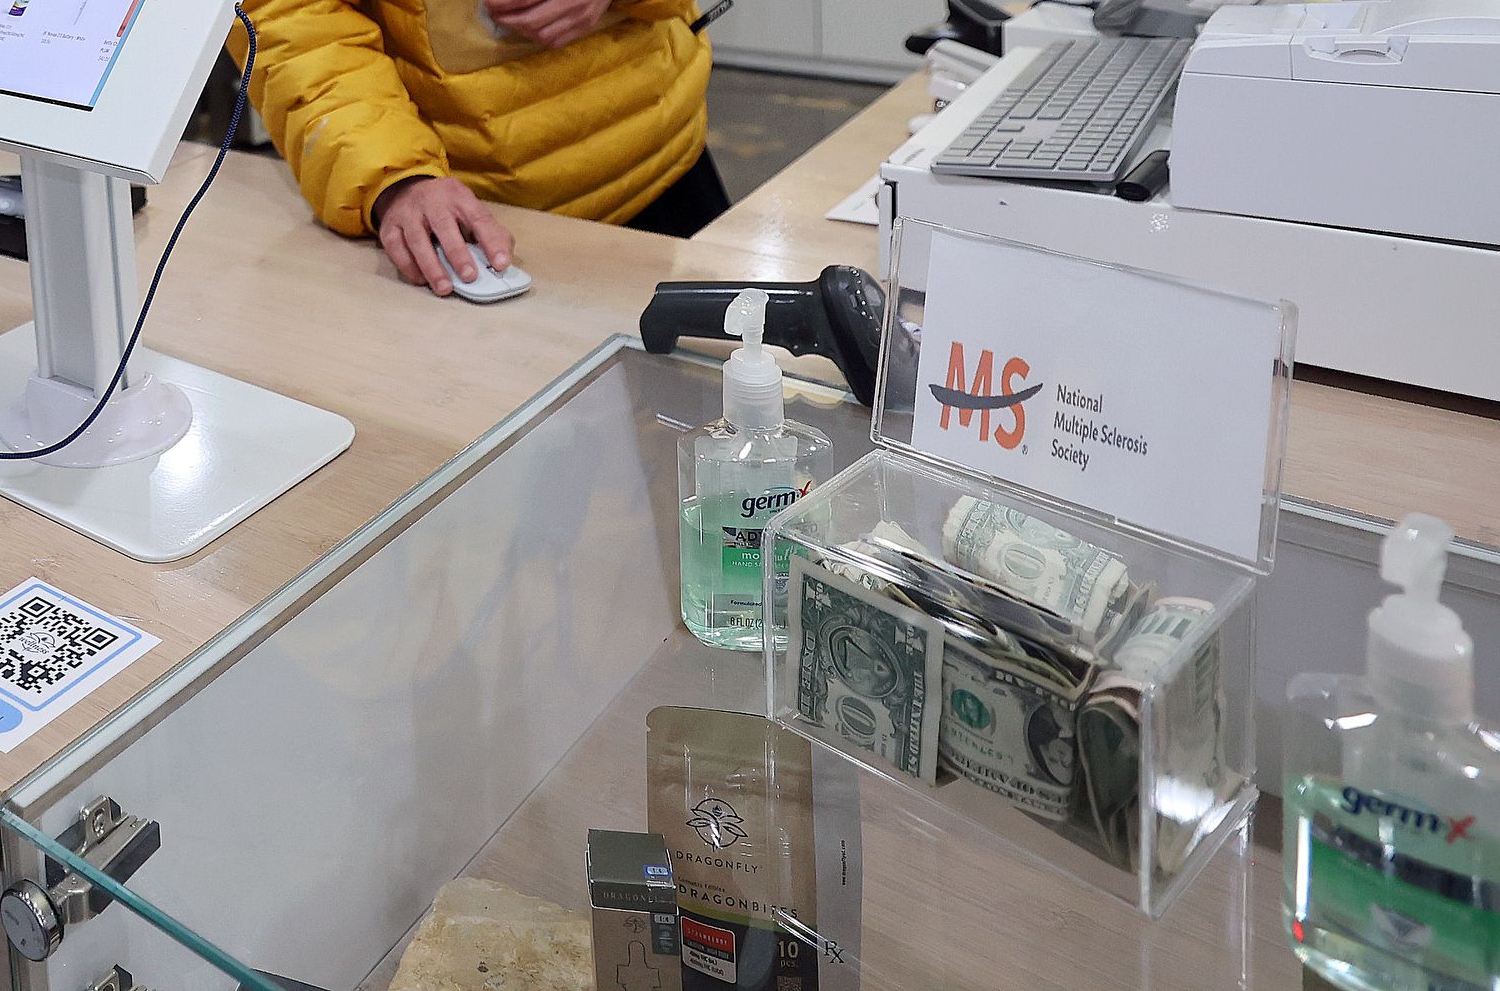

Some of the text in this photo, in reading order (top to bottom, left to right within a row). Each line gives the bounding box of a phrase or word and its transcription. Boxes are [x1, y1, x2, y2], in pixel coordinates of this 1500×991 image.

[940, 341, 1030, 450] MS
[1057, 384, 1103, 414] National
[1054, 412, 1148, 456] Multiple Sclerosis
[1051, 440, 1090, 472] Society
[730, 616, 736, 626] 8
[736, 617, 744, 626] FL
[745, 617, 755, 627] OZ
[676, 850, 758, 874] DRAGONFLY
[679, 884, 798, 919] DRAGONBITES
[778, 940, 799, 958] 10
